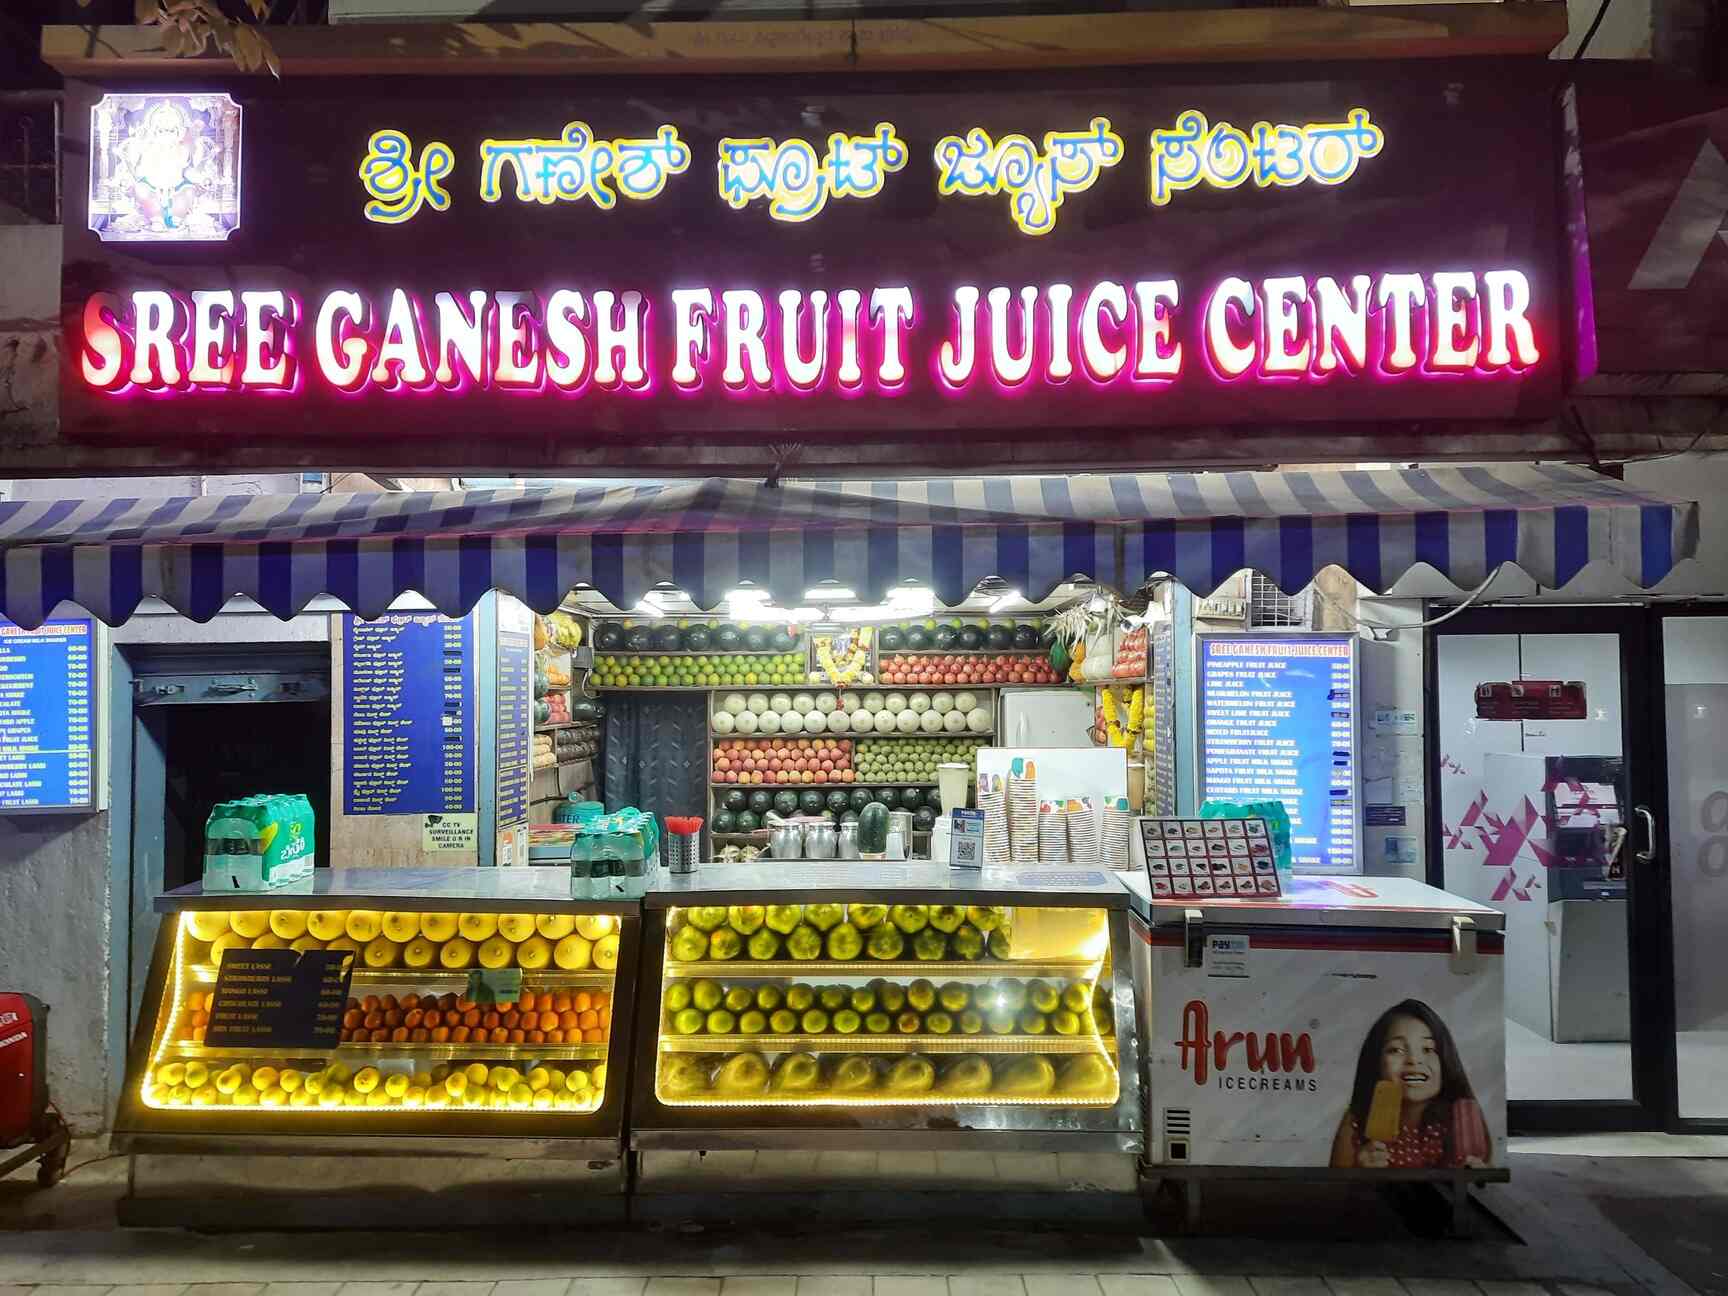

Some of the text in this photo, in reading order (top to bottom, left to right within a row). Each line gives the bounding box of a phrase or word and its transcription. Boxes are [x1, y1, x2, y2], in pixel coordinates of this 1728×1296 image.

[361, 108, 1385, 235] ಶ್ರೀ ಗಣೇಶ್ ಫ್ರೂಟ್ ಜ್ಯೂಸ್ ಸೆಂಟರ್
[80, 268, 1542, 393] SREE GANESH FRUIT JUICE CENTER
[1174, 1000, 1316, 1085] Arun
[1218, 1077, 1319, 1092] ICECREAMS
